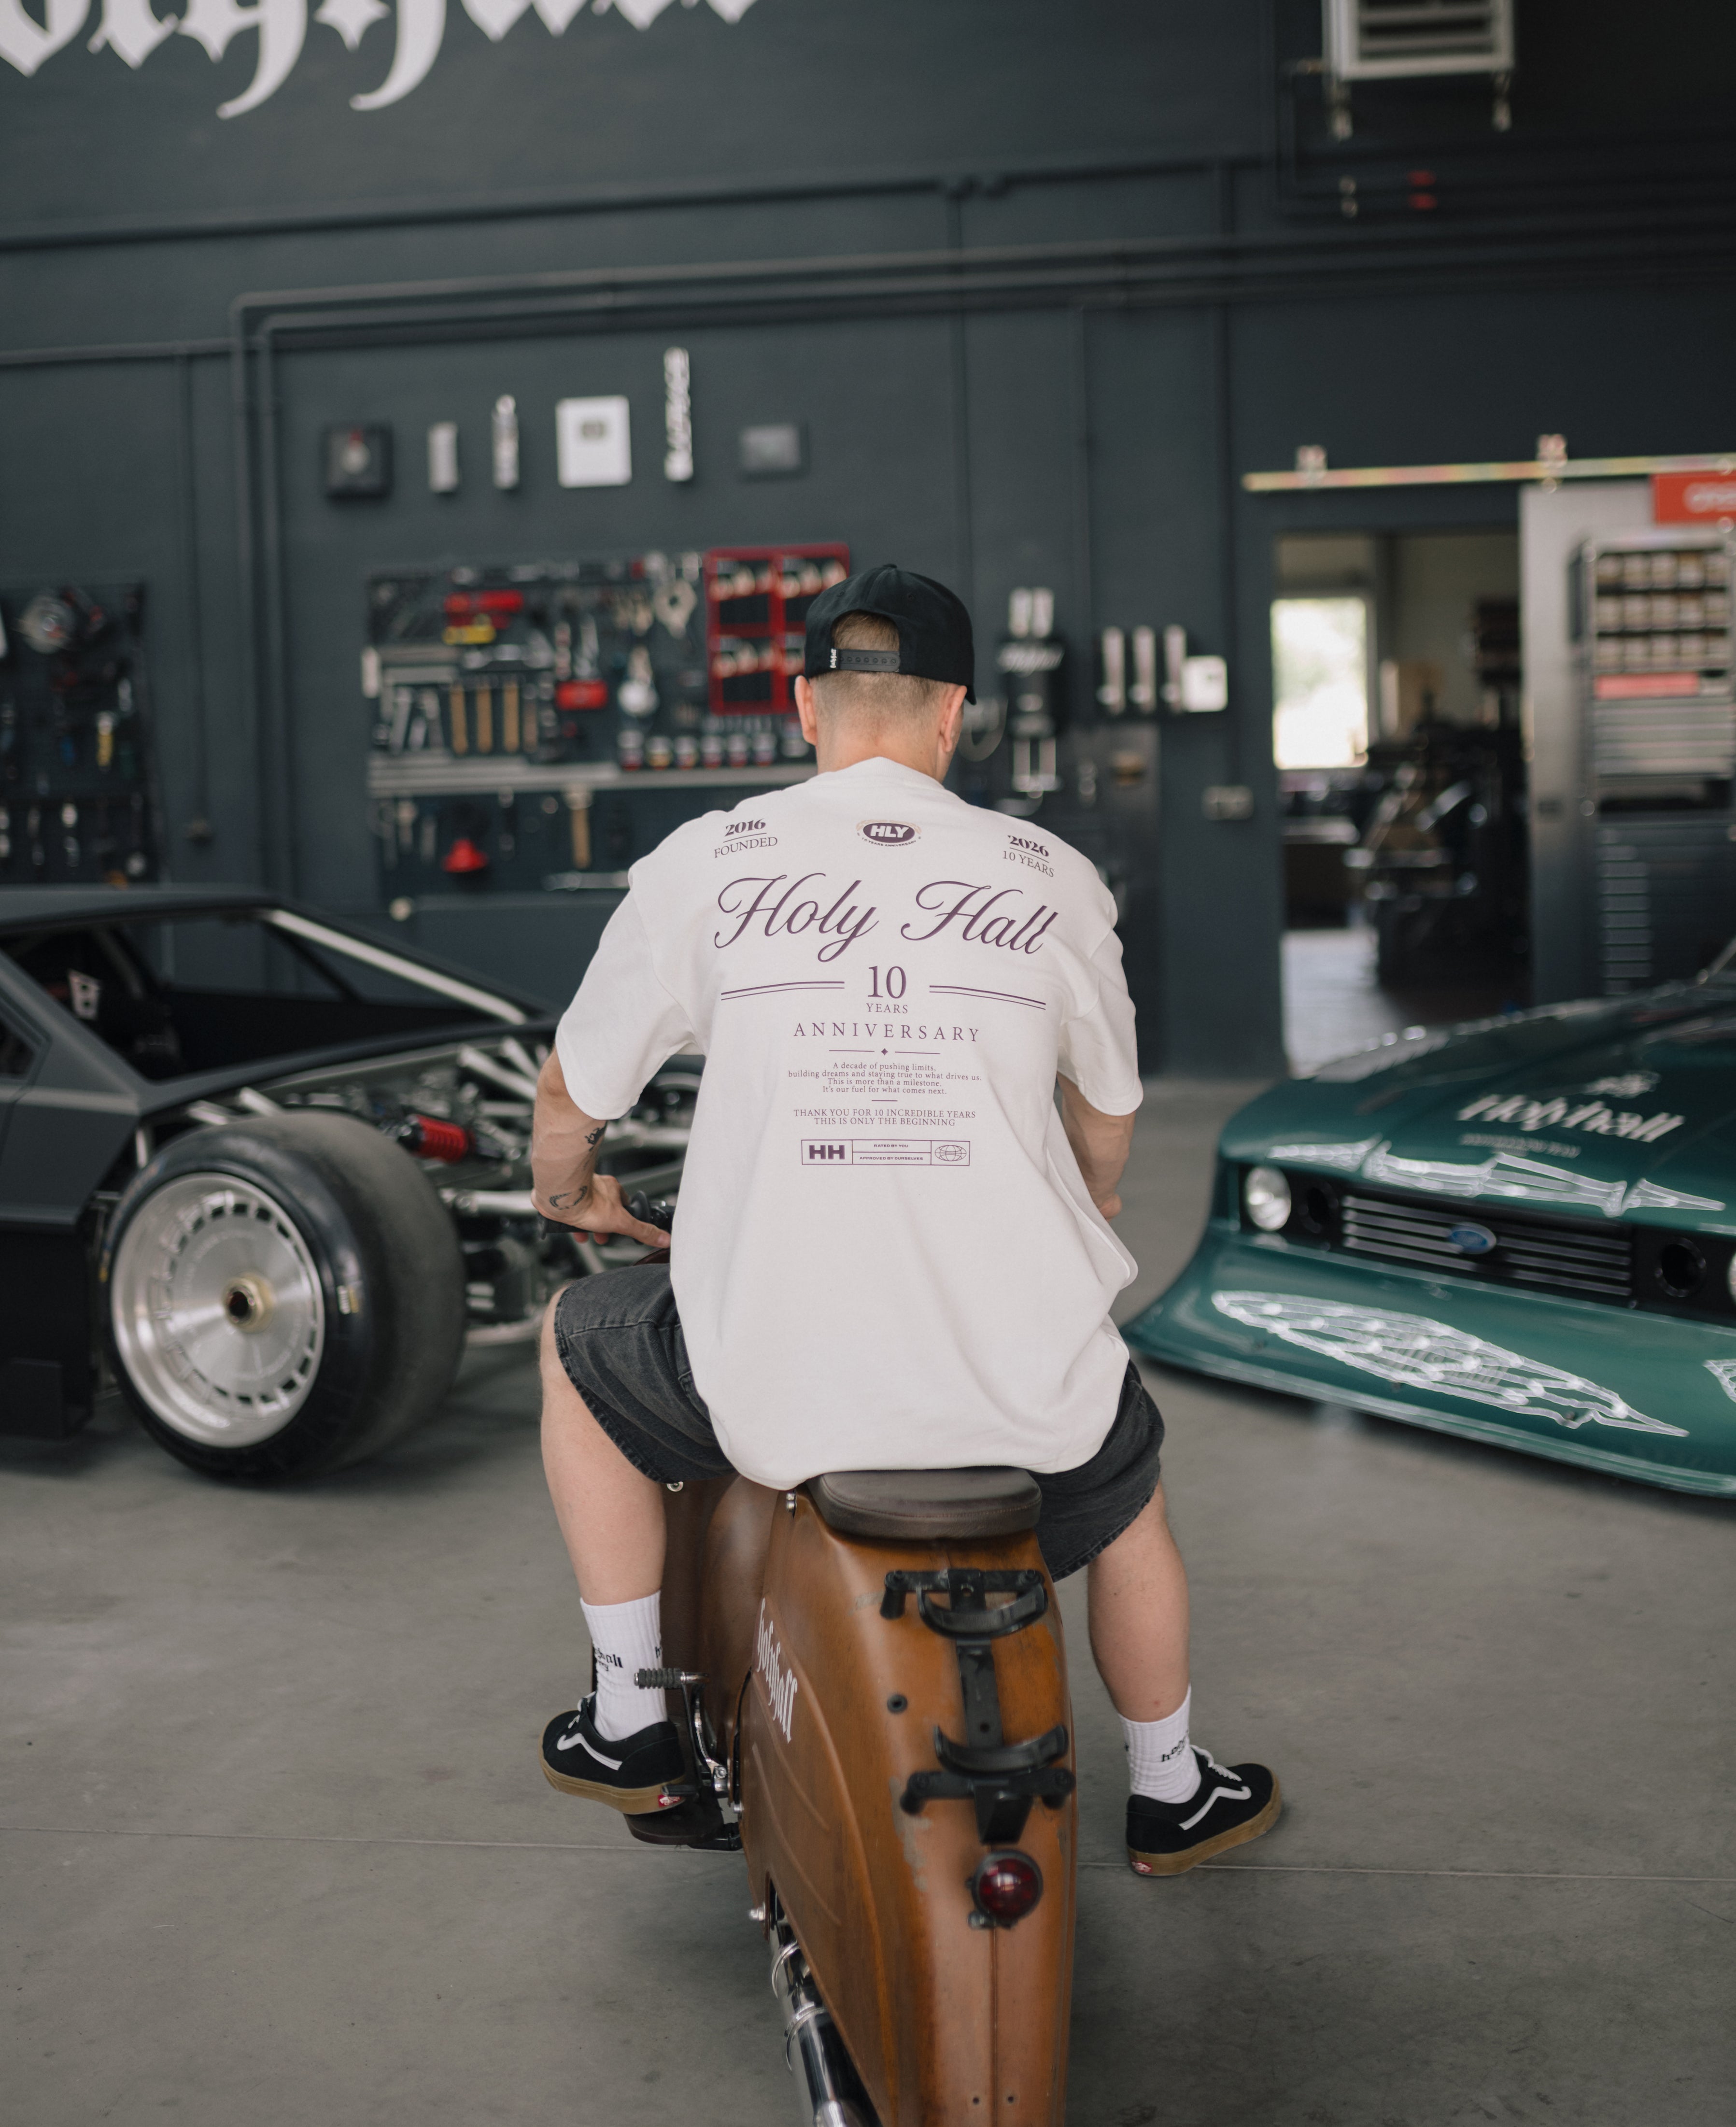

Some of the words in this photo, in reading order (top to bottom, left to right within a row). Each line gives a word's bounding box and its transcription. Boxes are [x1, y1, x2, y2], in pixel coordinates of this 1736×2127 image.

[725, 818, 766, 837] 2016
[870, 825, 909, 838] HLY
[714, 837, 778, 858] FOUNDED
[1007, 835, 1049, 858] 2026
[1002, 850, 1016, 862] 10
[1018, 854, 1055, 878] YEARS
[714, 873, 879, 963] Holy
[901, 880, 1059, 954] Hall
[867, 965, 907, 999] 10
[866, 1003, 908, 1014] YEARS
[793, 1022, 979, 1042] ANNIVERSARY
[788, 1070, 819, 1078] building
[868, 1071, 895, 1079] staying
[880, 1063, 910, 1071] pushing
[887, 1109, 944, 1118] INCREDIBLE
[900, 1118, 956, 1126] BEGINNING
[808, 1145, 845, 1160] HH
